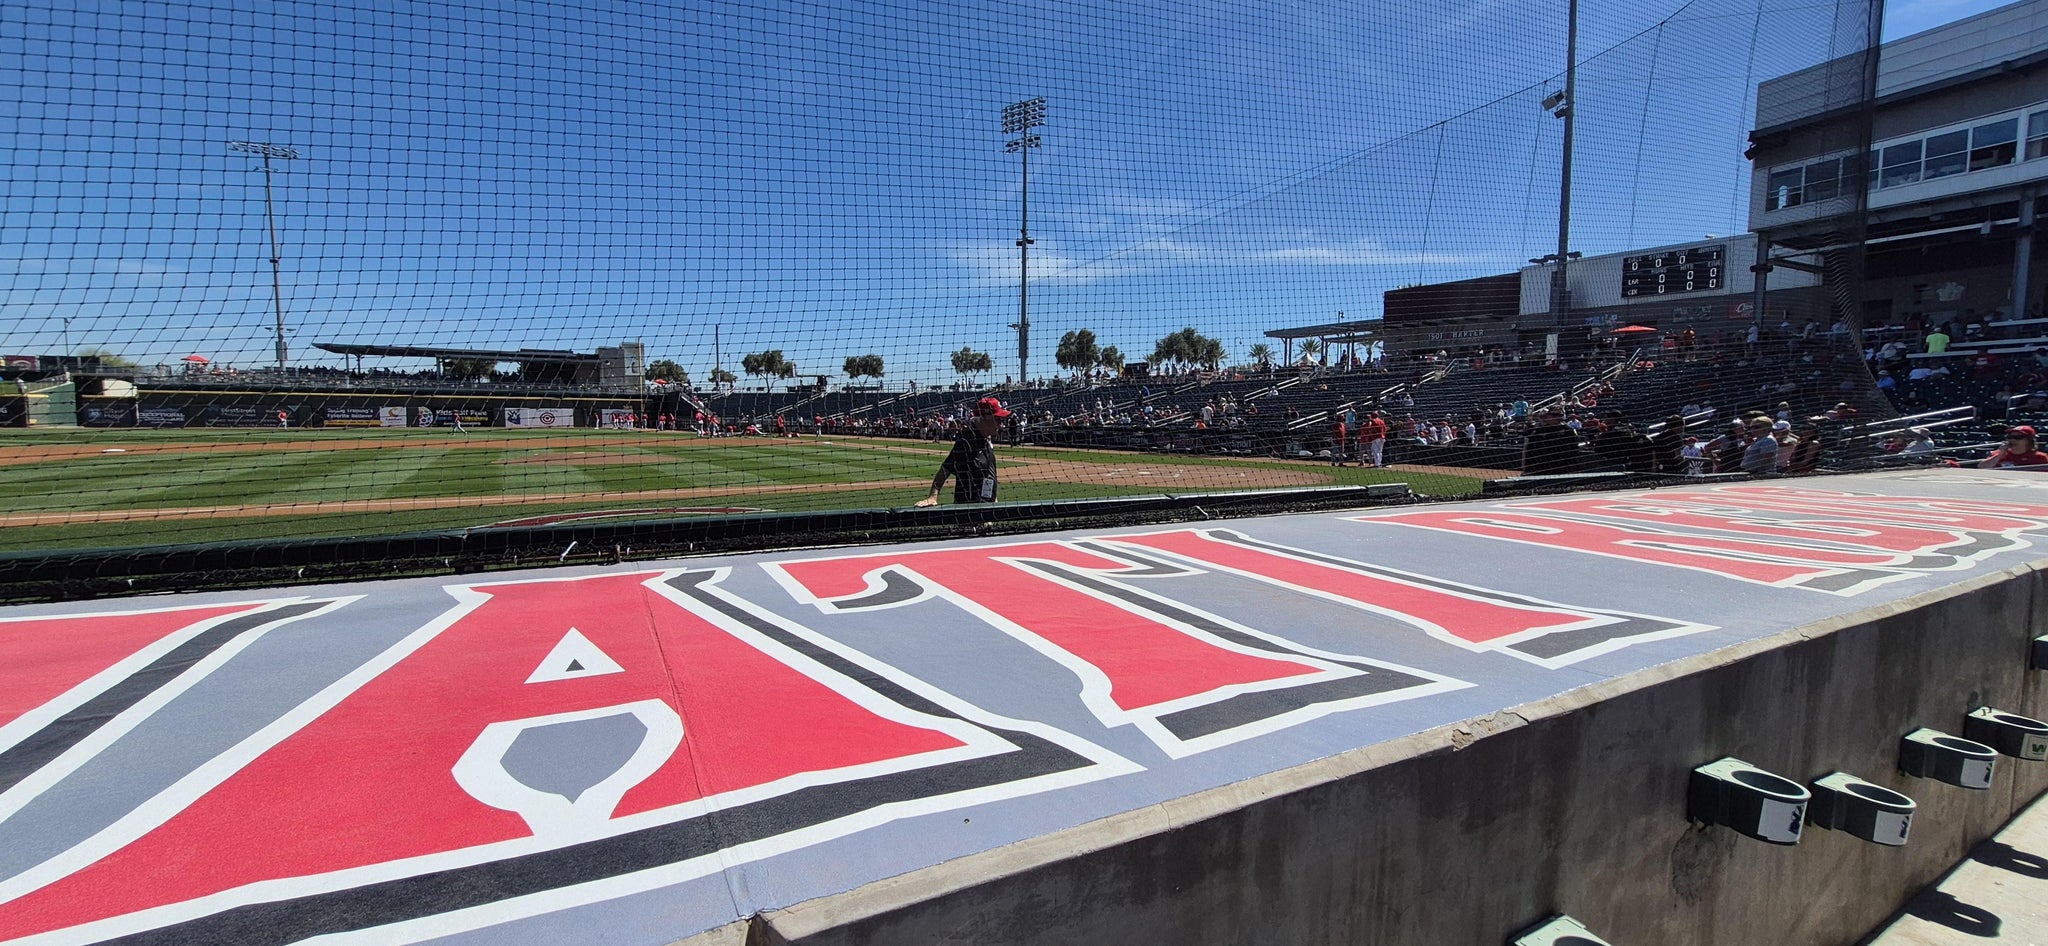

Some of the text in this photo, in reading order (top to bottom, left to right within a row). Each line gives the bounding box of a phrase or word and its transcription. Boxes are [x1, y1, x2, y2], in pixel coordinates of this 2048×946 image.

[1632, 262, 1638, 270] 0
[1656, 259, 1662, 267] 0
[1679, 256, 1685, 264] 0
[1659, 274, 1665, 283] 0
[1687, 271, 1693, 279] 0
[1710, 268, 1716, 277] 0
[1658, 285, 1664, 293] 0
[1687, 281, 1692, 290] 0
[1709, 279, 1716, 287] 0
